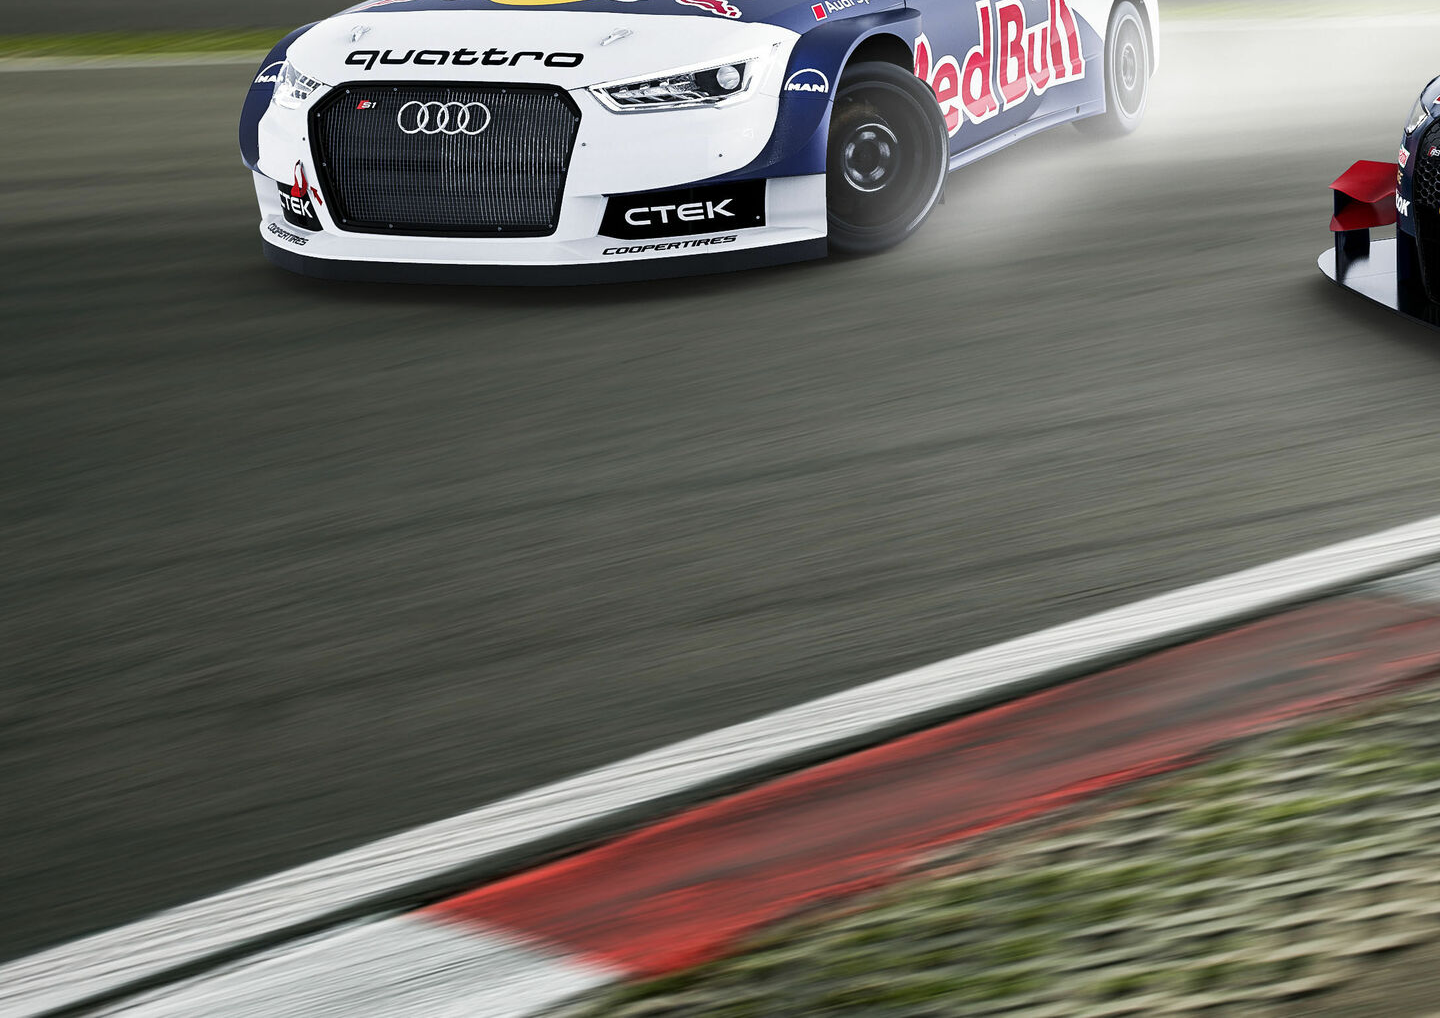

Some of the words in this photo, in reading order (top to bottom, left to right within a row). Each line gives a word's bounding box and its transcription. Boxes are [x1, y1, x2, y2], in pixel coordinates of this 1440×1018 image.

[345, 48, 584, 71] quattro
[788, 83, 824, 93] MAN
[624, 198, 735, 226] CTEK
[602, 235, 738, 255] COOPERTIRES
